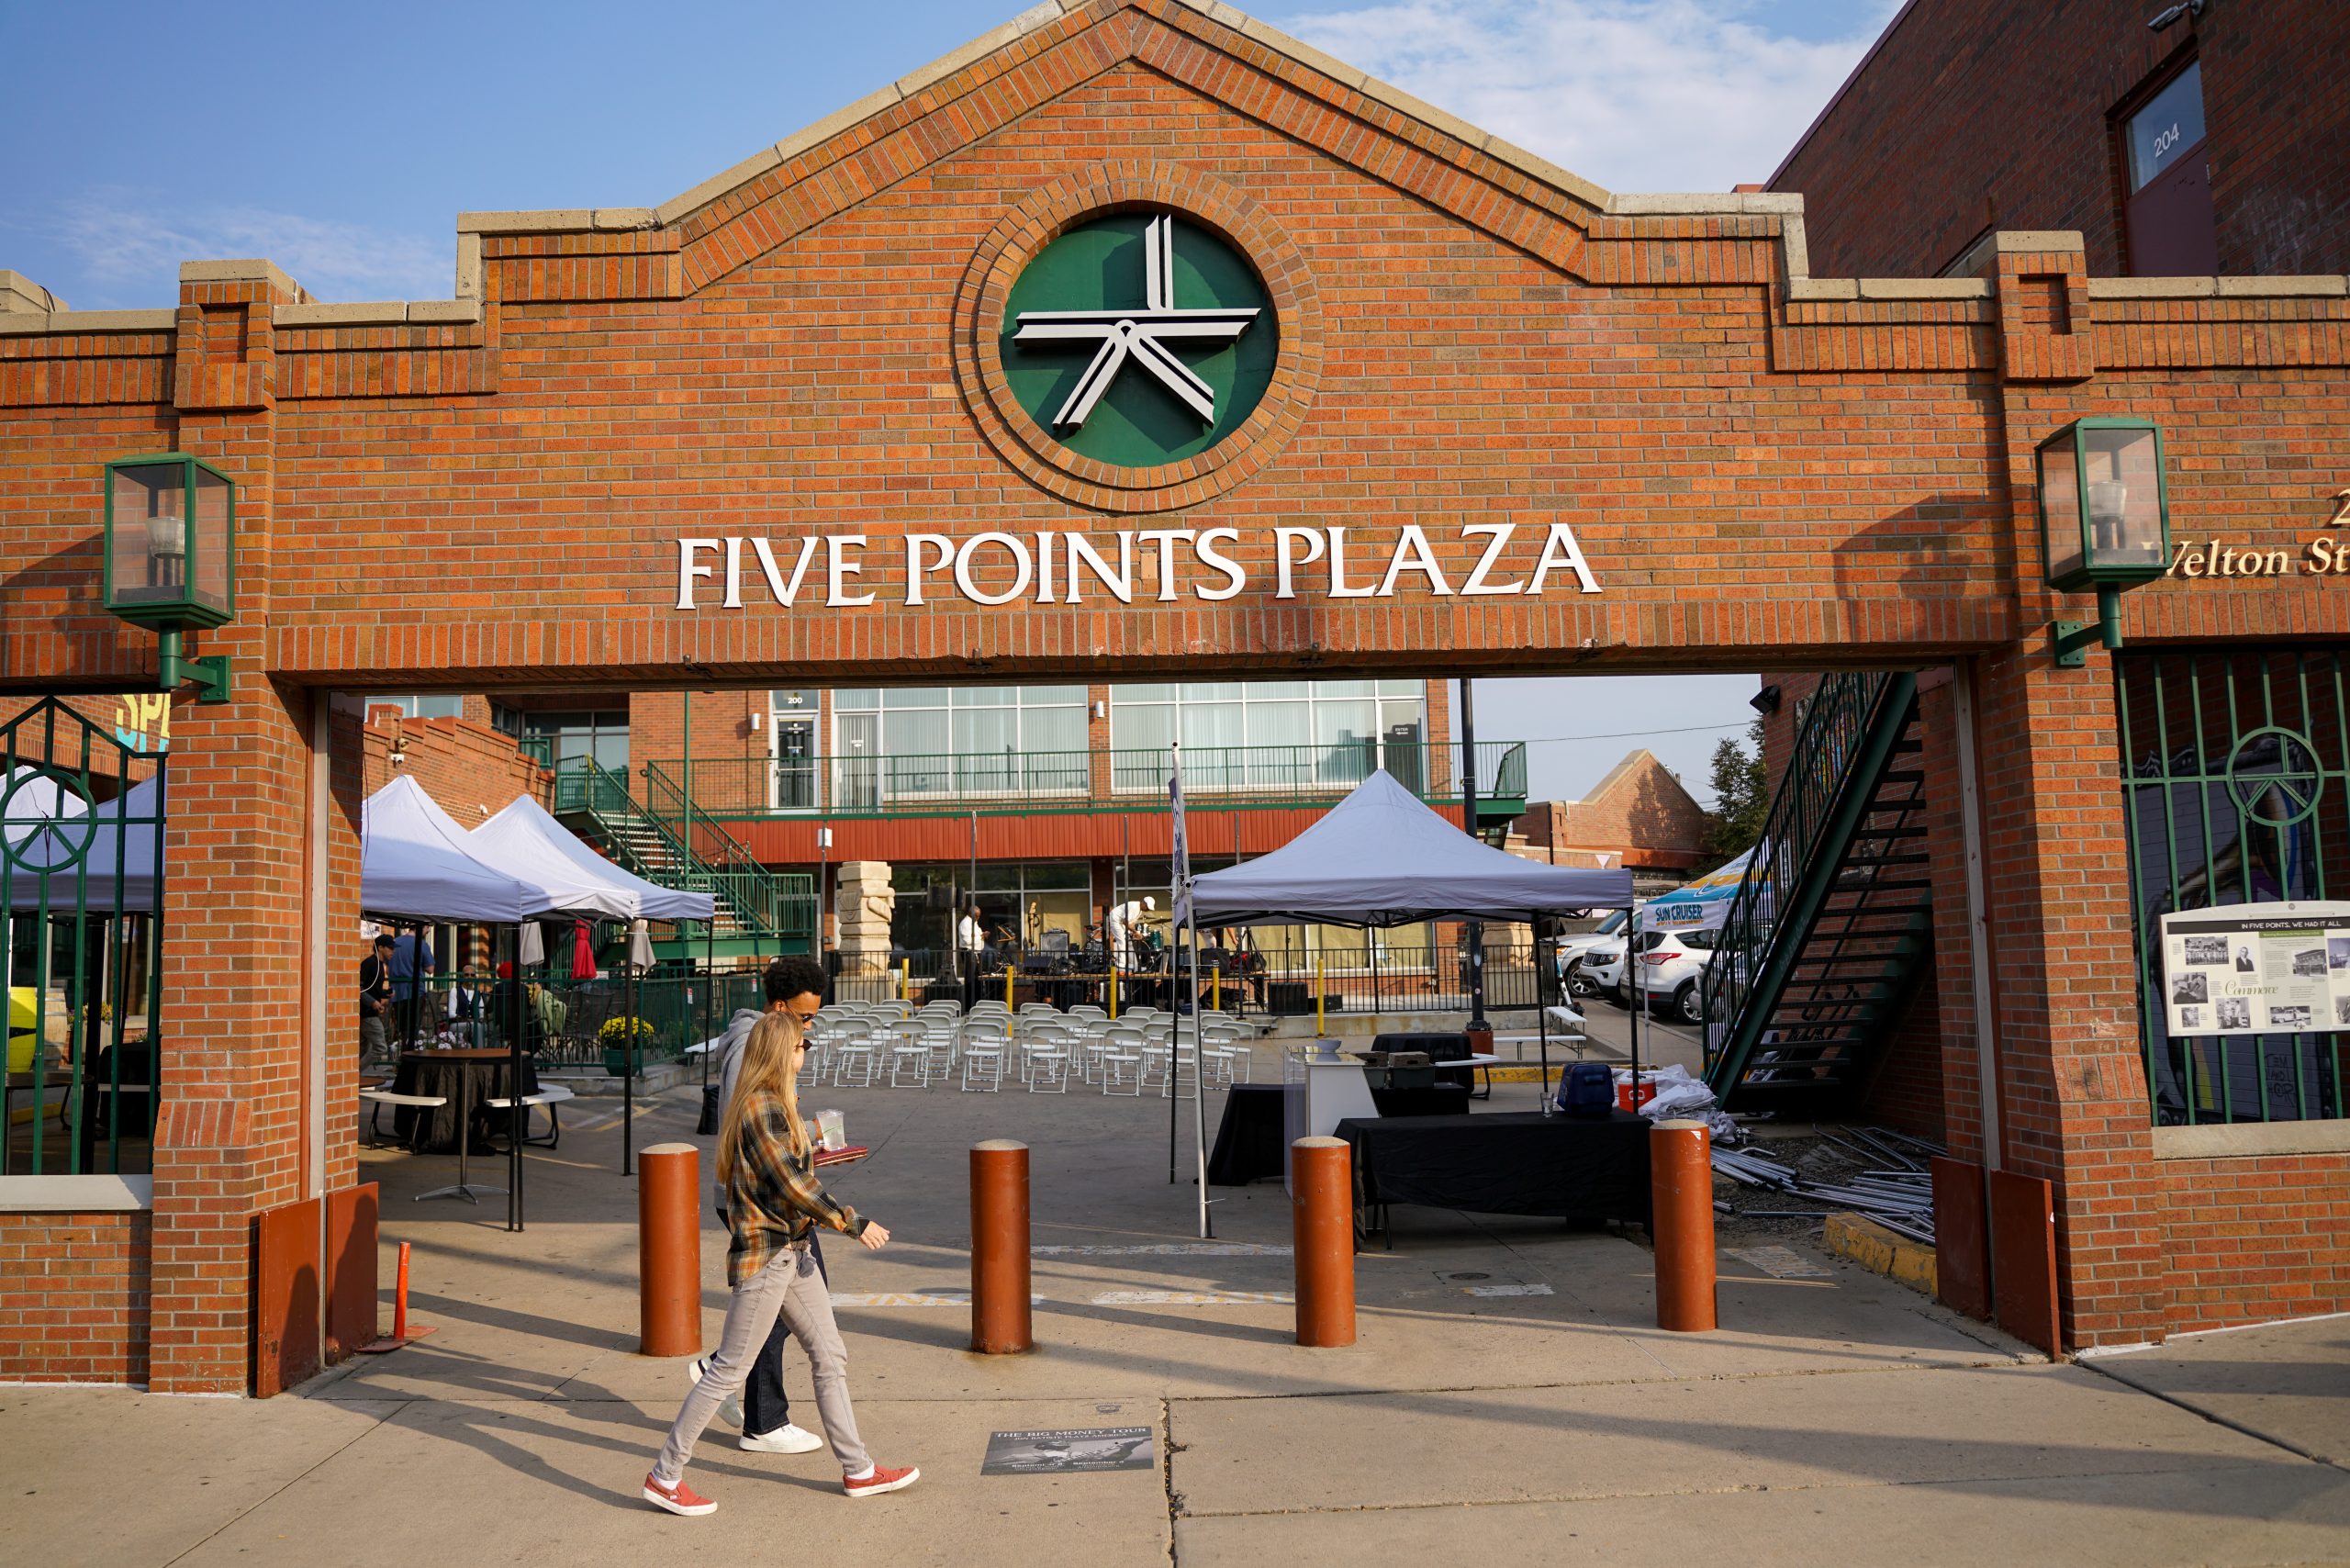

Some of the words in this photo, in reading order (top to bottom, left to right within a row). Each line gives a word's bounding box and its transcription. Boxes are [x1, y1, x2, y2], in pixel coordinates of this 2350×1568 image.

[2154, 122, 2180, 158] 204
[675, 534, 877, 610] FIVE
[903, 527, 1246, 605] POINTS
[1273, 522, 1604, 599] PLAZA
[1655, 907, 1671, 922] SUN
[1672, 904, 1704, 921] CRUISER
[2225, 980, 2278, 995] Commerce
